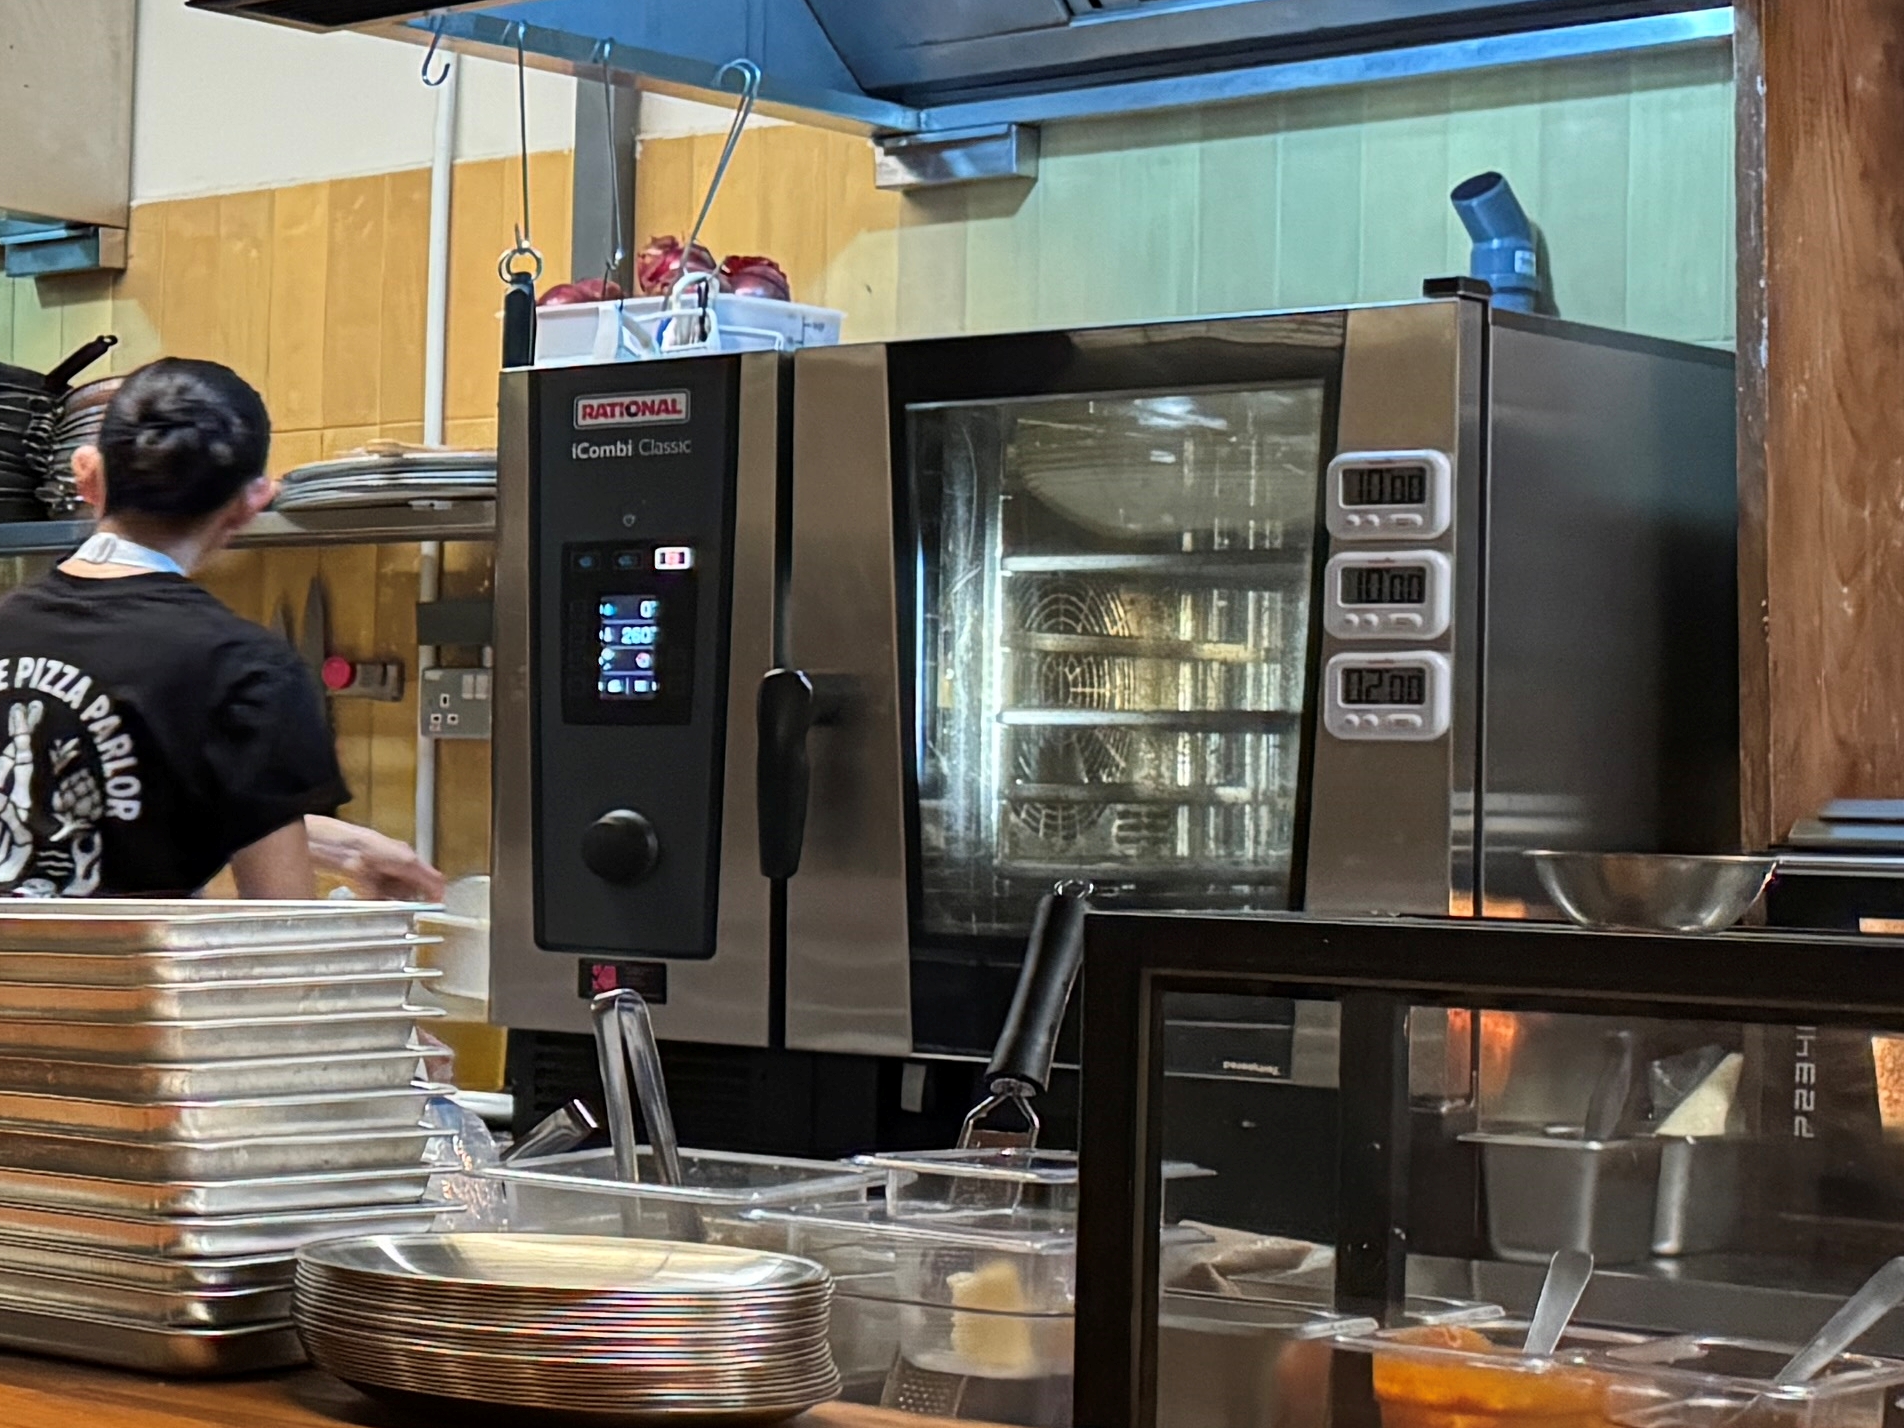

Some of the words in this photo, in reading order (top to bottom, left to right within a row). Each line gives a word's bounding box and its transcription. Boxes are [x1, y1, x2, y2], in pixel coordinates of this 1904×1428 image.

[580, 398, 683, 421] RATIONAL
[572, 439, 633, 460] iCombi
[638, 438, 692, 456] Classic
[14, 657, 93, 710] PIZZA
[80, 694, 142, 822] PARLOR
